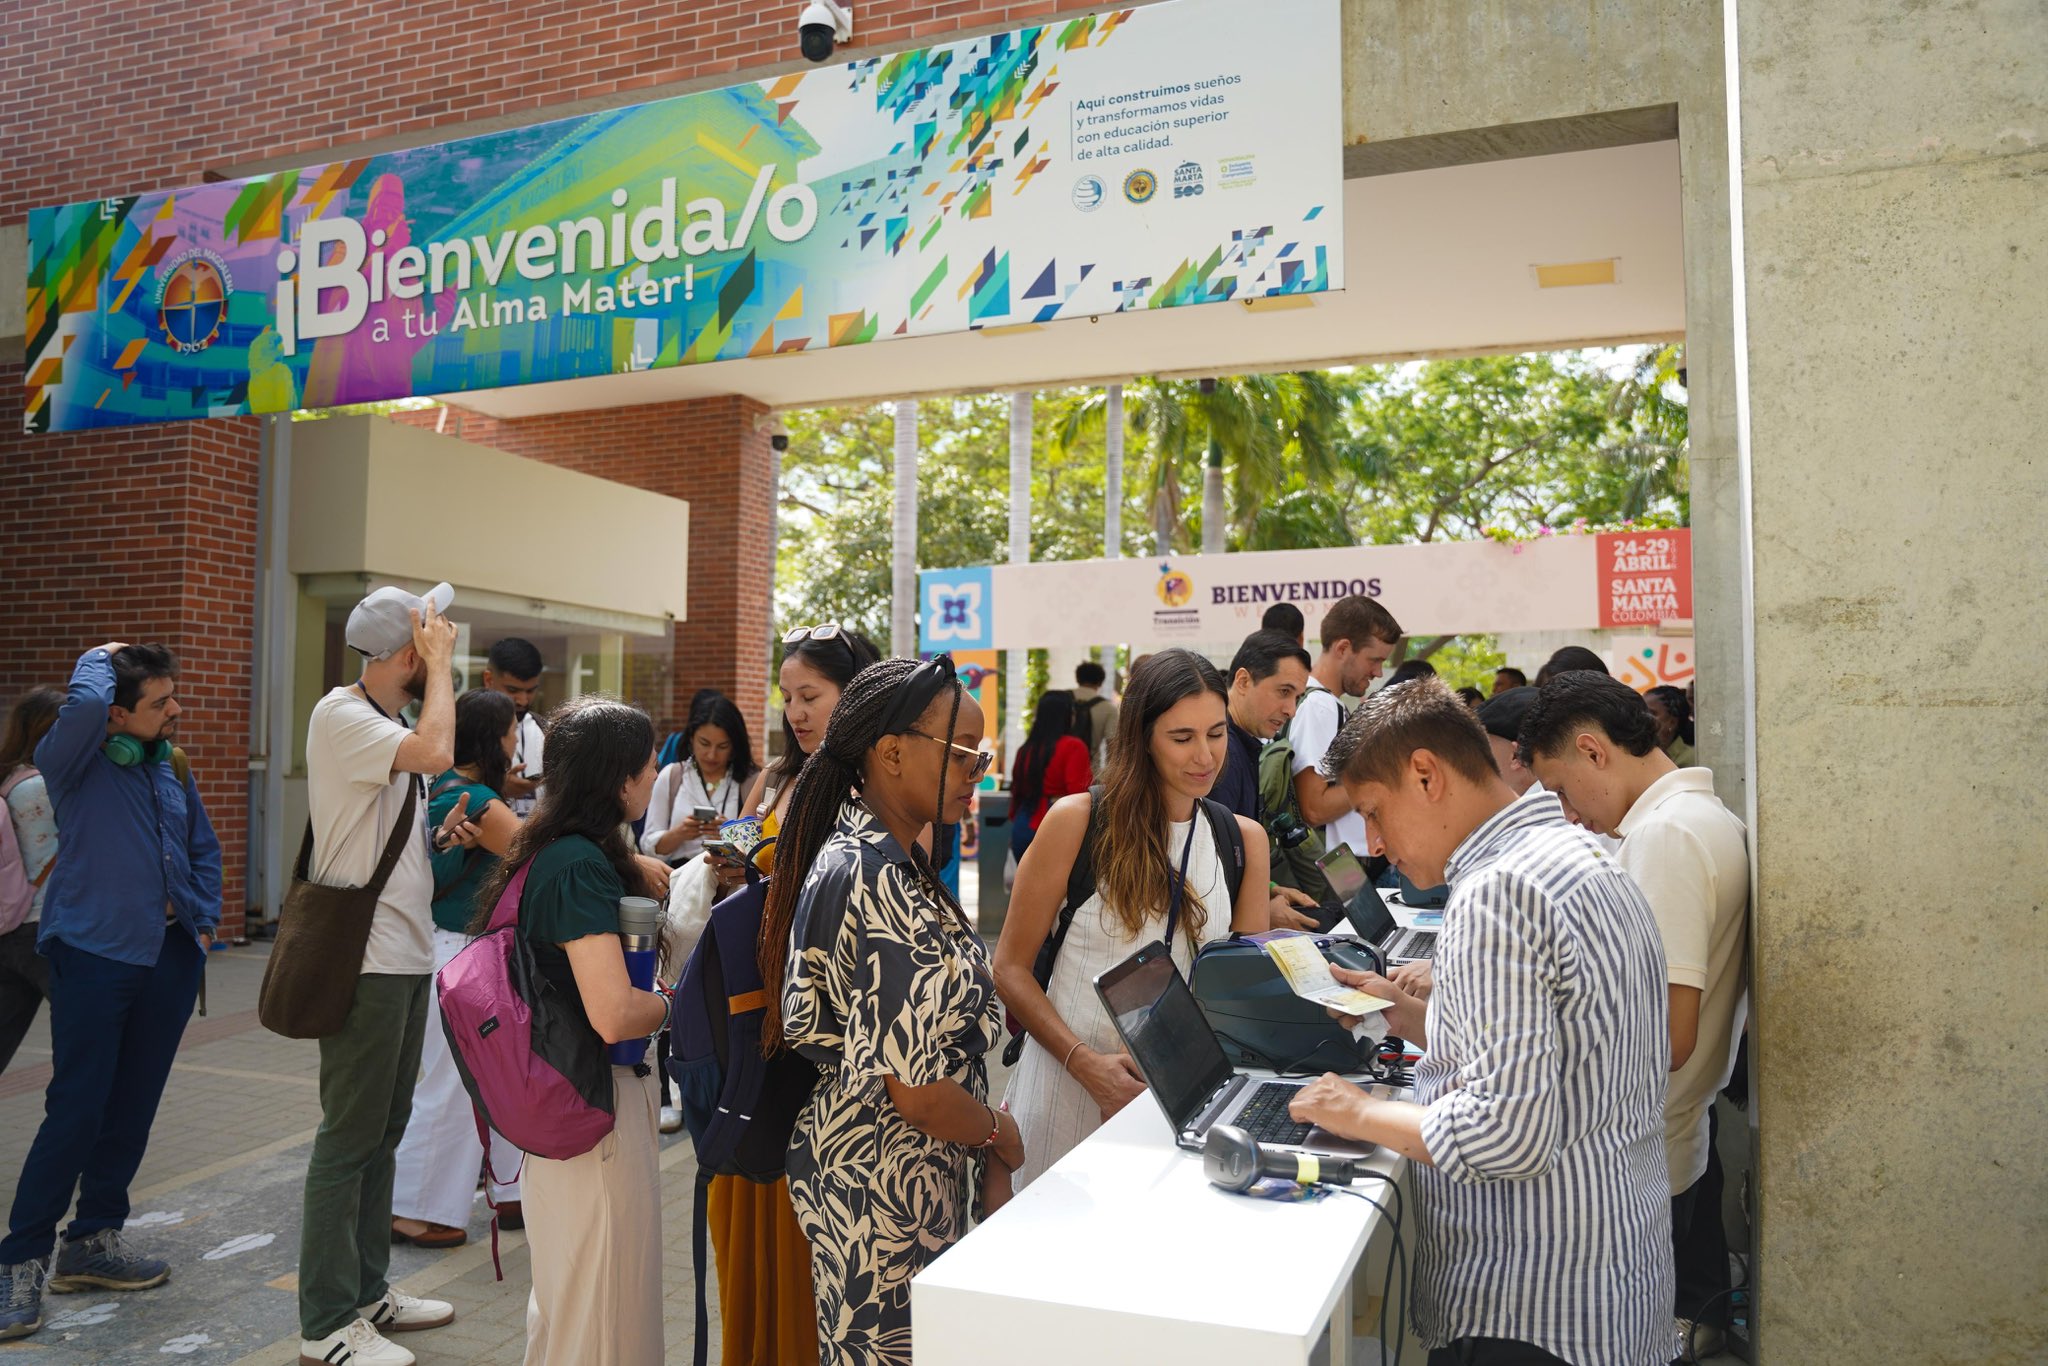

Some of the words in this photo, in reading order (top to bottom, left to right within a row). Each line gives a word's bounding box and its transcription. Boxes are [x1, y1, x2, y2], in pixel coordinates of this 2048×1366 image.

[1108, 82, 1191, 105] construimos
[1194, 74, 1242, 91] sueños
[1076, 118, 1085, 131] y
[1087, 101, 1188, 126] transformamos
[1190, 93, 1225, 108] vidas
[1076, 132, 1101, 144] con
[1103, 119, 1170, 140] educación
[1173, 110, 1230, 129] superior
[1077, 148, 1093, 161] de
[1095, 145, 1120, 158] alta
[1123, 134, 1174, 153] calidad.
[1174, 166, 1203, 177] SANTA
[1174, 173, 1204, 183] MARTA
[153, 251, 189, 305] UNIVERSIDAD
[203, 247, 235, 296] MAGDALENA
[372, 317, 390, 343] a
[401, 308, 439, 339] tu
[450, 292, 548, 333] Alma
[562, 263, 694, 317] Mater!
[1613, 538, 1670, 556] 24-29
[1612, 554, 1672, 573] ABRIL
[1210, 578, 1383, 605] BIENVENIDOS
[1611, 576, 1678, 595] SANTA
[1611, 593, 1680, 612] MARTA
[1611, 607, 1680, 623] COLOMBIA
